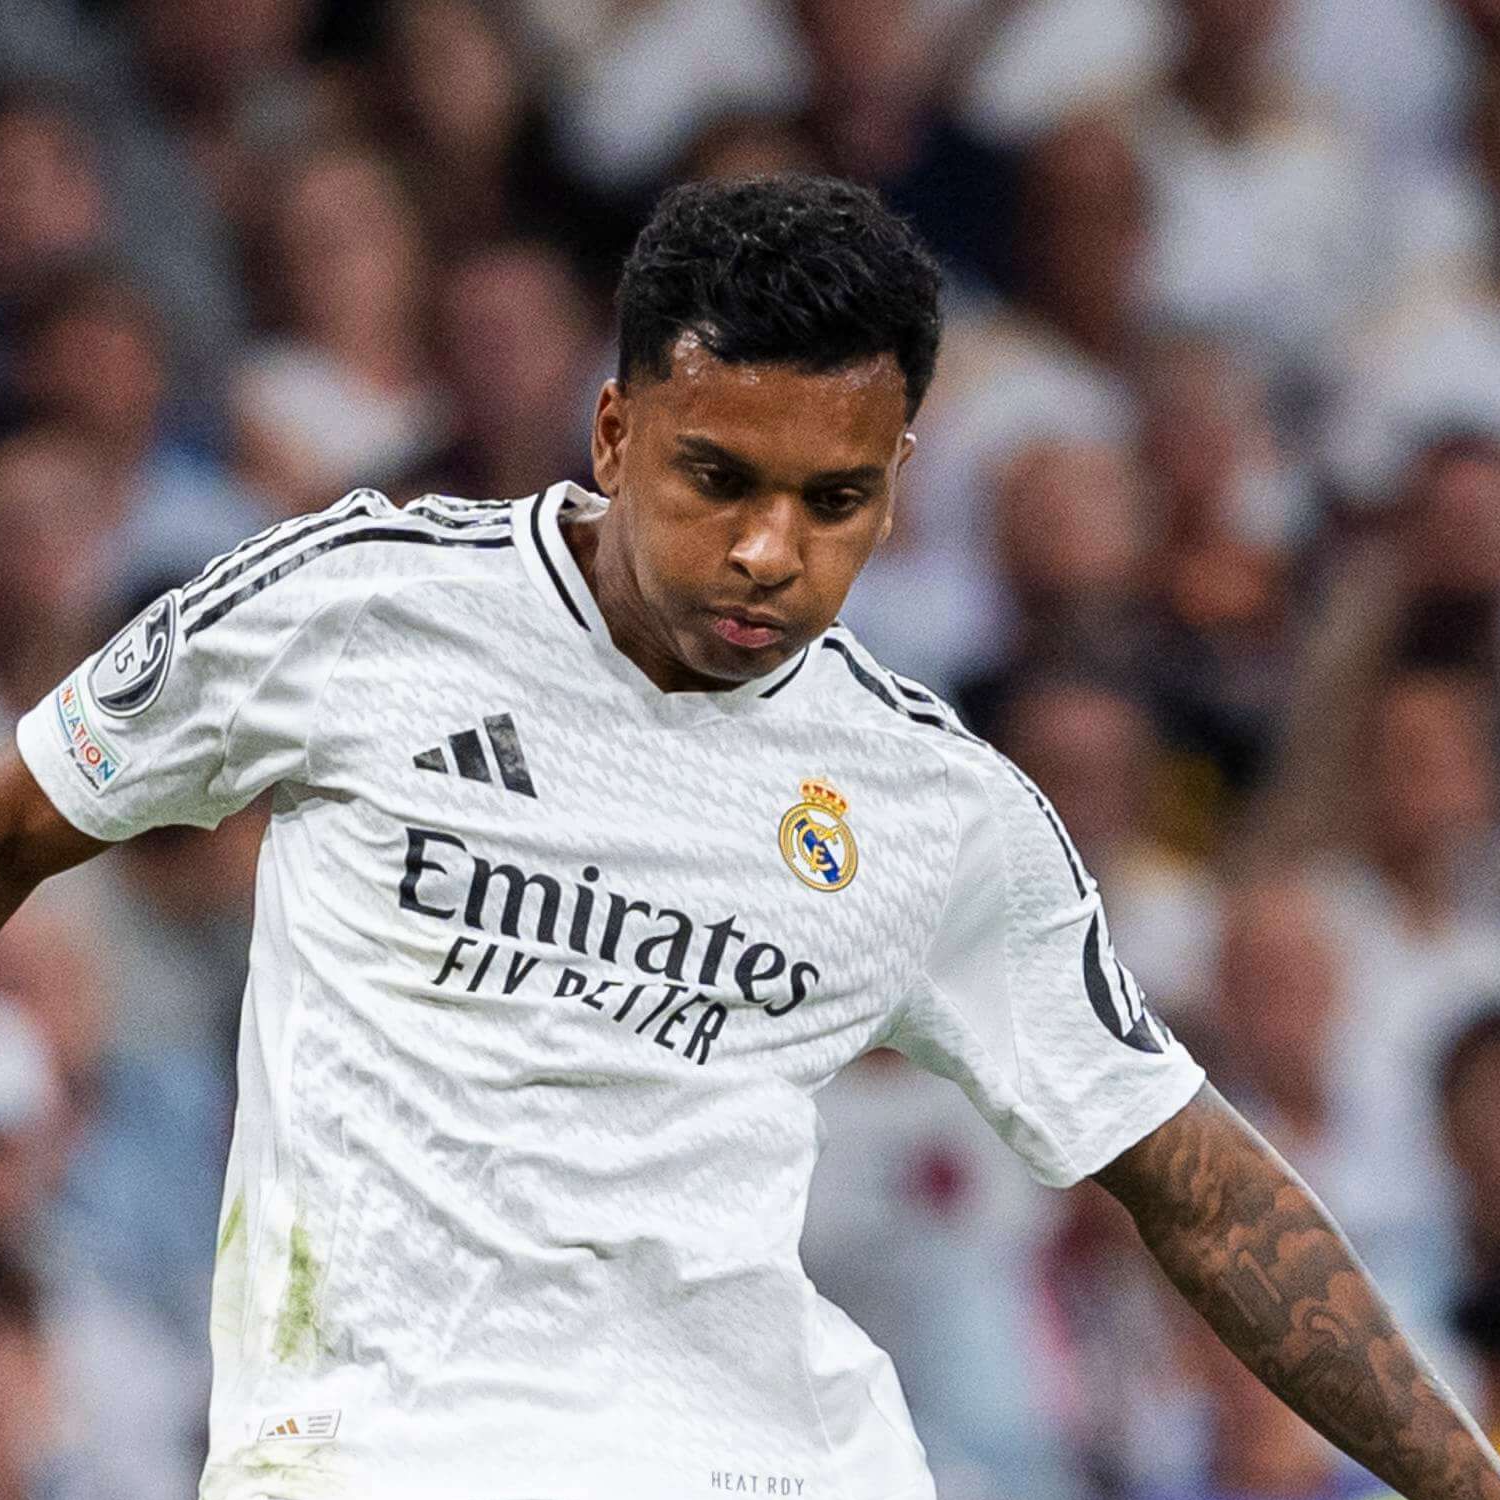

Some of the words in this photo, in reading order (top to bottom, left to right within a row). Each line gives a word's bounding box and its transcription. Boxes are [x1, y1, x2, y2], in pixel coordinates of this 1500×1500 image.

[113, 637, 135, 675] 15
[59, 682, 116, 782] NDATION
[399, 826, 820, 1018] Emirates
[710, 1471, 759, 1494] HEAT
